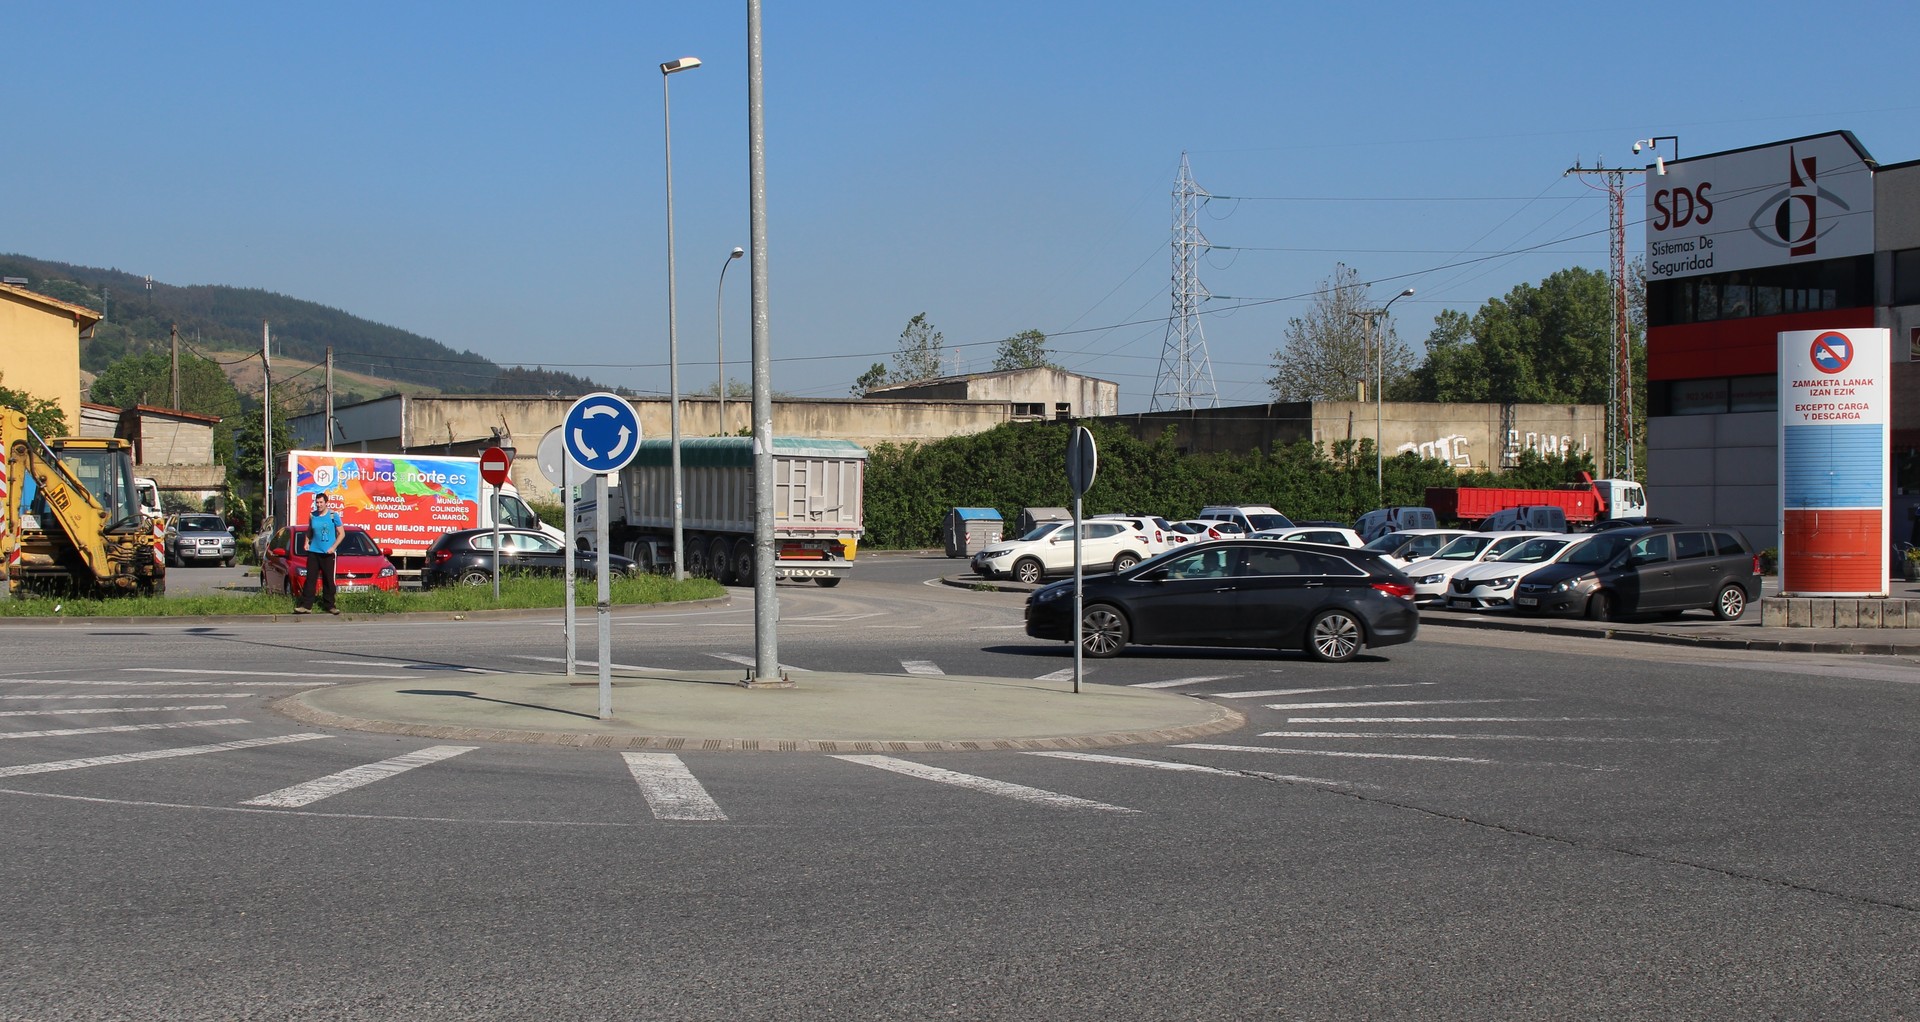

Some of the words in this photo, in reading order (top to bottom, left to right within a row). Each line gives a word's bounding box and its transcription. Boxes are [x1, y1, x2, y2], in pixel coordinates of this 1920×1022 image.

[1653, 181, 1714, 232] SDS
[1651, 240, 1695, 257] Sistemas
[1699, 236, 1714, 251] De
[1651, 252, 1714, 277] Seguridad
[1792, 379, 1841, 388] ZAMAKETA
[1843, 378, 1874, 387] LANAK
[1809, 388, 1831, 397] IZAN
[1834, 388, 1855, 396] EZIK
[1795, 403, 1835, 412] EXCEPTO
[1838, 402, 1870, 411] CARGA
[1803, 413, 1809, 421] Y
[1811, 412, 1861, 421] DESCARGA
[337, 467, 398, 484] pinturas
[407, 470, 467, 485] norte.es
[50, 486, 69, 511] JCB
[372, 495, 406, 503] TRAPAGA
[436, 497, 464, 505] MUNGIA
[430, 505, 470, 513] COLINDRES
[375, 524, 393, 532] QUE
[395, 524, 425, 532] MEJOR
[427, 525, 457, 533] PINTA!!
[783, 569, 835, 577] TISVOL
